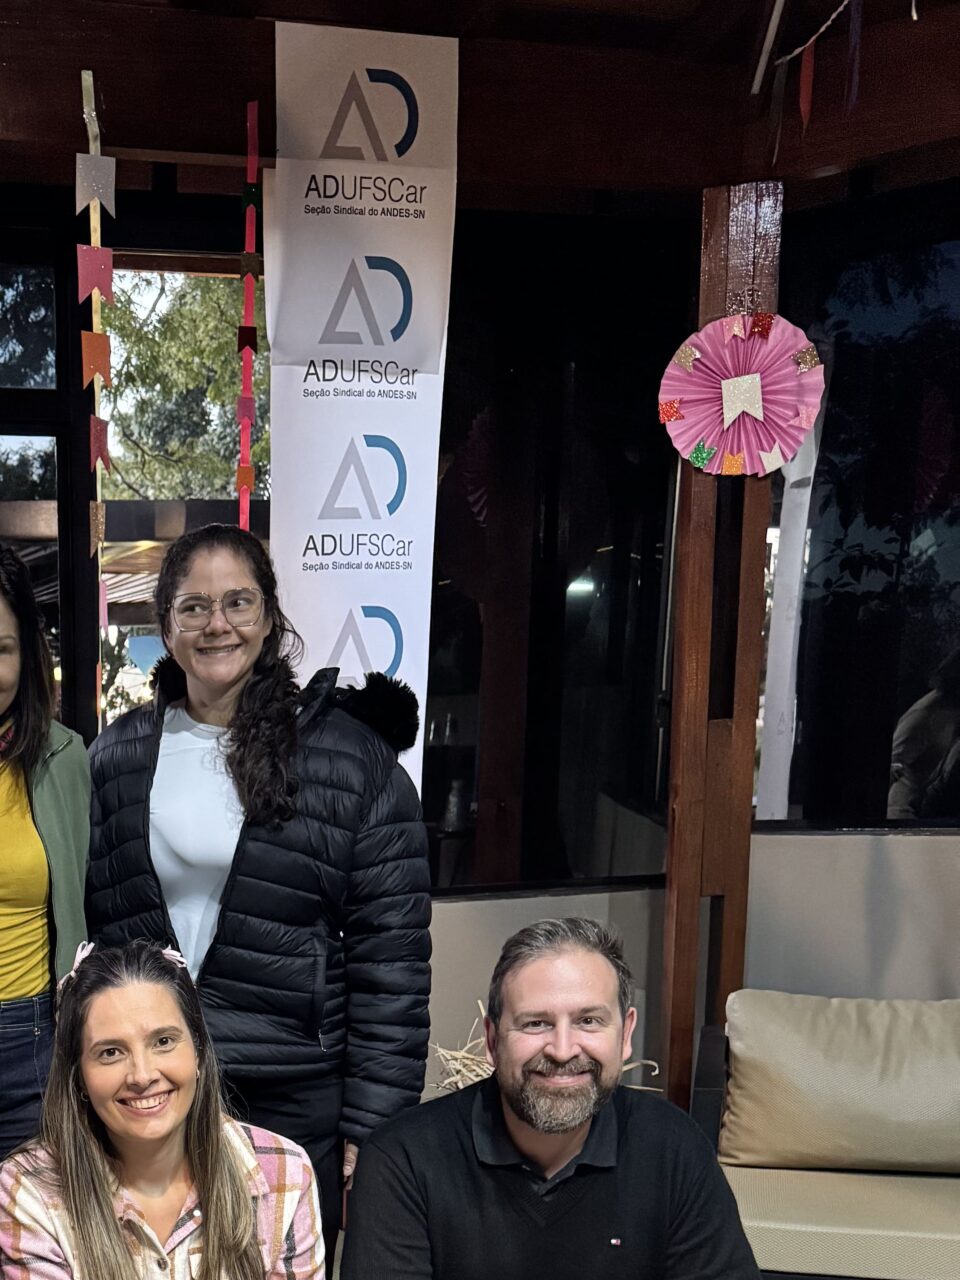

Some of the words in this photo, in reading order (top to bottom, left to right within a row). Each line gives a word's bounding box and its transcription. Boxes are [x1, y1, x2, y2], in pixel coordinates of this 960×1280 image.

[304, 174, 427, 204] ADUFSCar
[304, 205, 332, 216] Seção
[334, 205, 366, 216] Sindical
[368, 208, 379, 216] do
[380, 207, 426, 219] ANDES-SN
[303, 359, 418, 386] ADUFSCar
[303, 389, 331, 399] Seção
[333, 388, 365, 398] Sindical
[366, 389, 376, 398] do
[377, 390, 417, 400] ANDES-SN
[302, 533, 413, 557] ADUFSCar
[302, 562, 330, 572] Seção
[331, 561, 362, 570] Sindical
[364, 561, 373, 570] do
[374, 561, 413, 570] ANDES-SN
